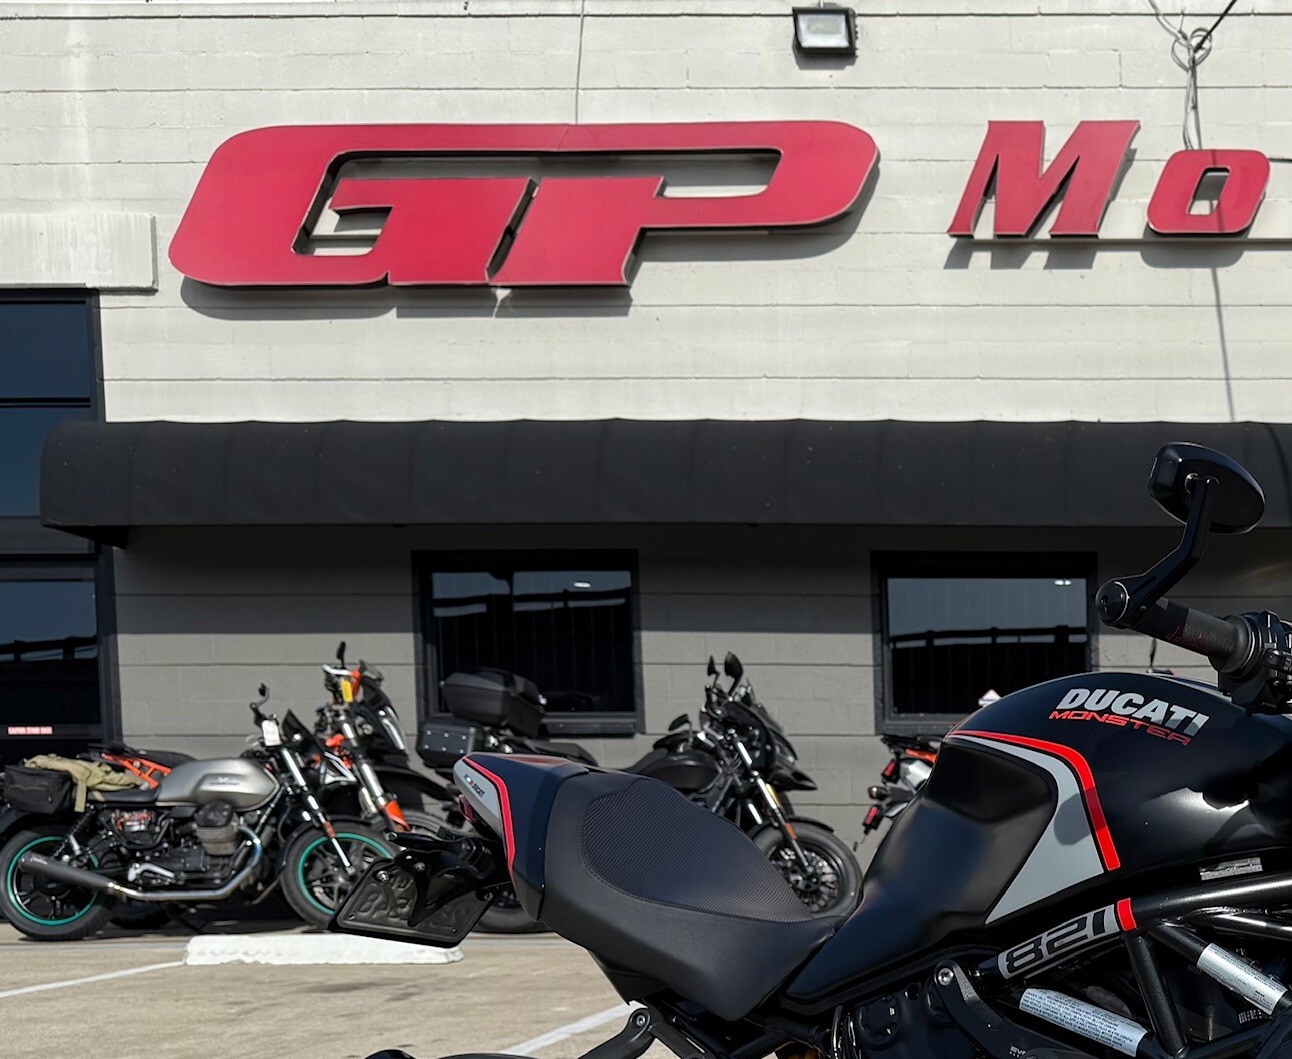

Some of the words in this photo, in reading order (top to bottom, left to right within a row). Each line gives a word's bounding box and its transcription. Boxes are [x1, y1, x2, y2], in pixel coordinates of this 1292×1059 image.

[168, 119, 881, 287] GP
[1048, 710, 1192, 747] MONSTER
[1055, 687, 1210, 737] DUCATI
[1005, 908, 1106, 974] 821
